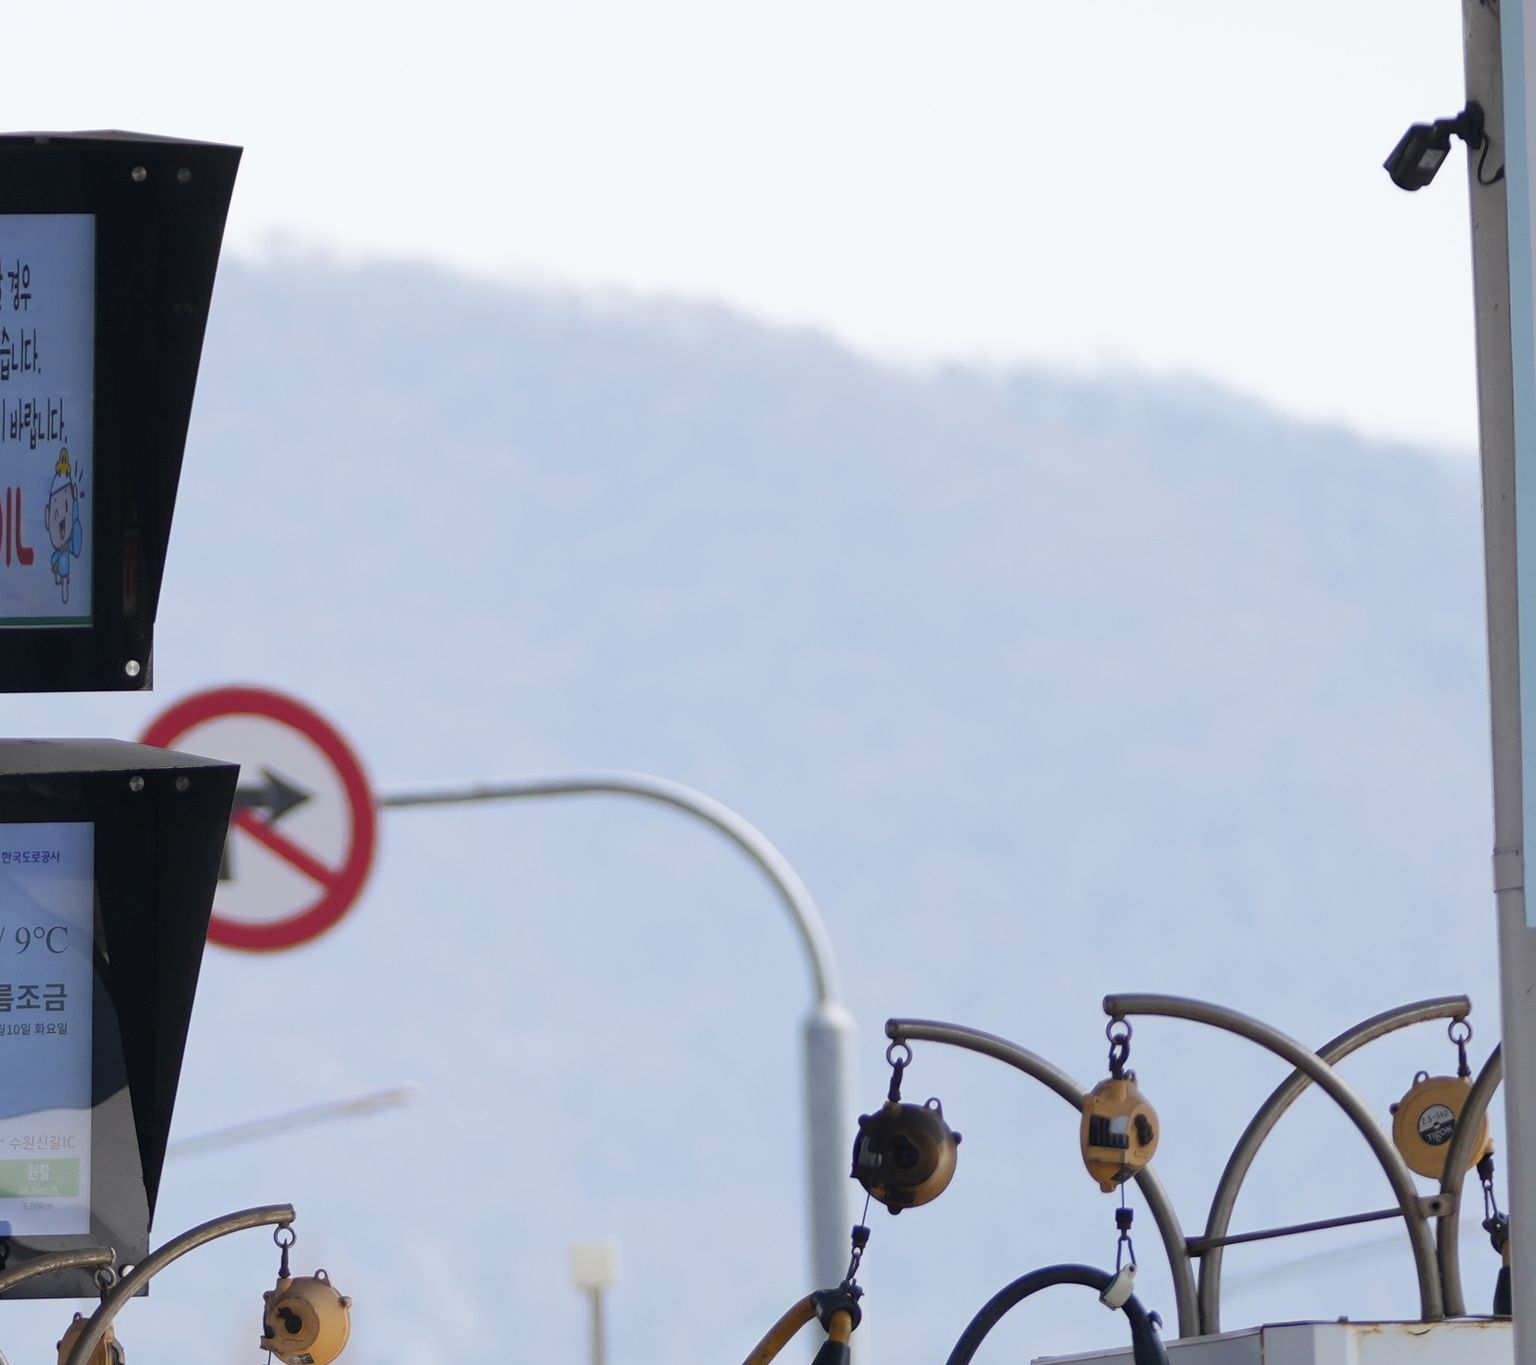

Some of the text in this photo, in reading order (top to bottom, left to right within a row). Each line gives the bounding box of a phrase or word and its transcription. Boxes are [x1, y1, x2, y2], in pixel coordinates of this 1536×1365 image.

[8, 260, 31, 311] 경우
[9, 397, 67, 450] 바랍니다.
[2, 850, 60, 865] 한국도로공사
[35, 1022, 68, 1035] 화요일
